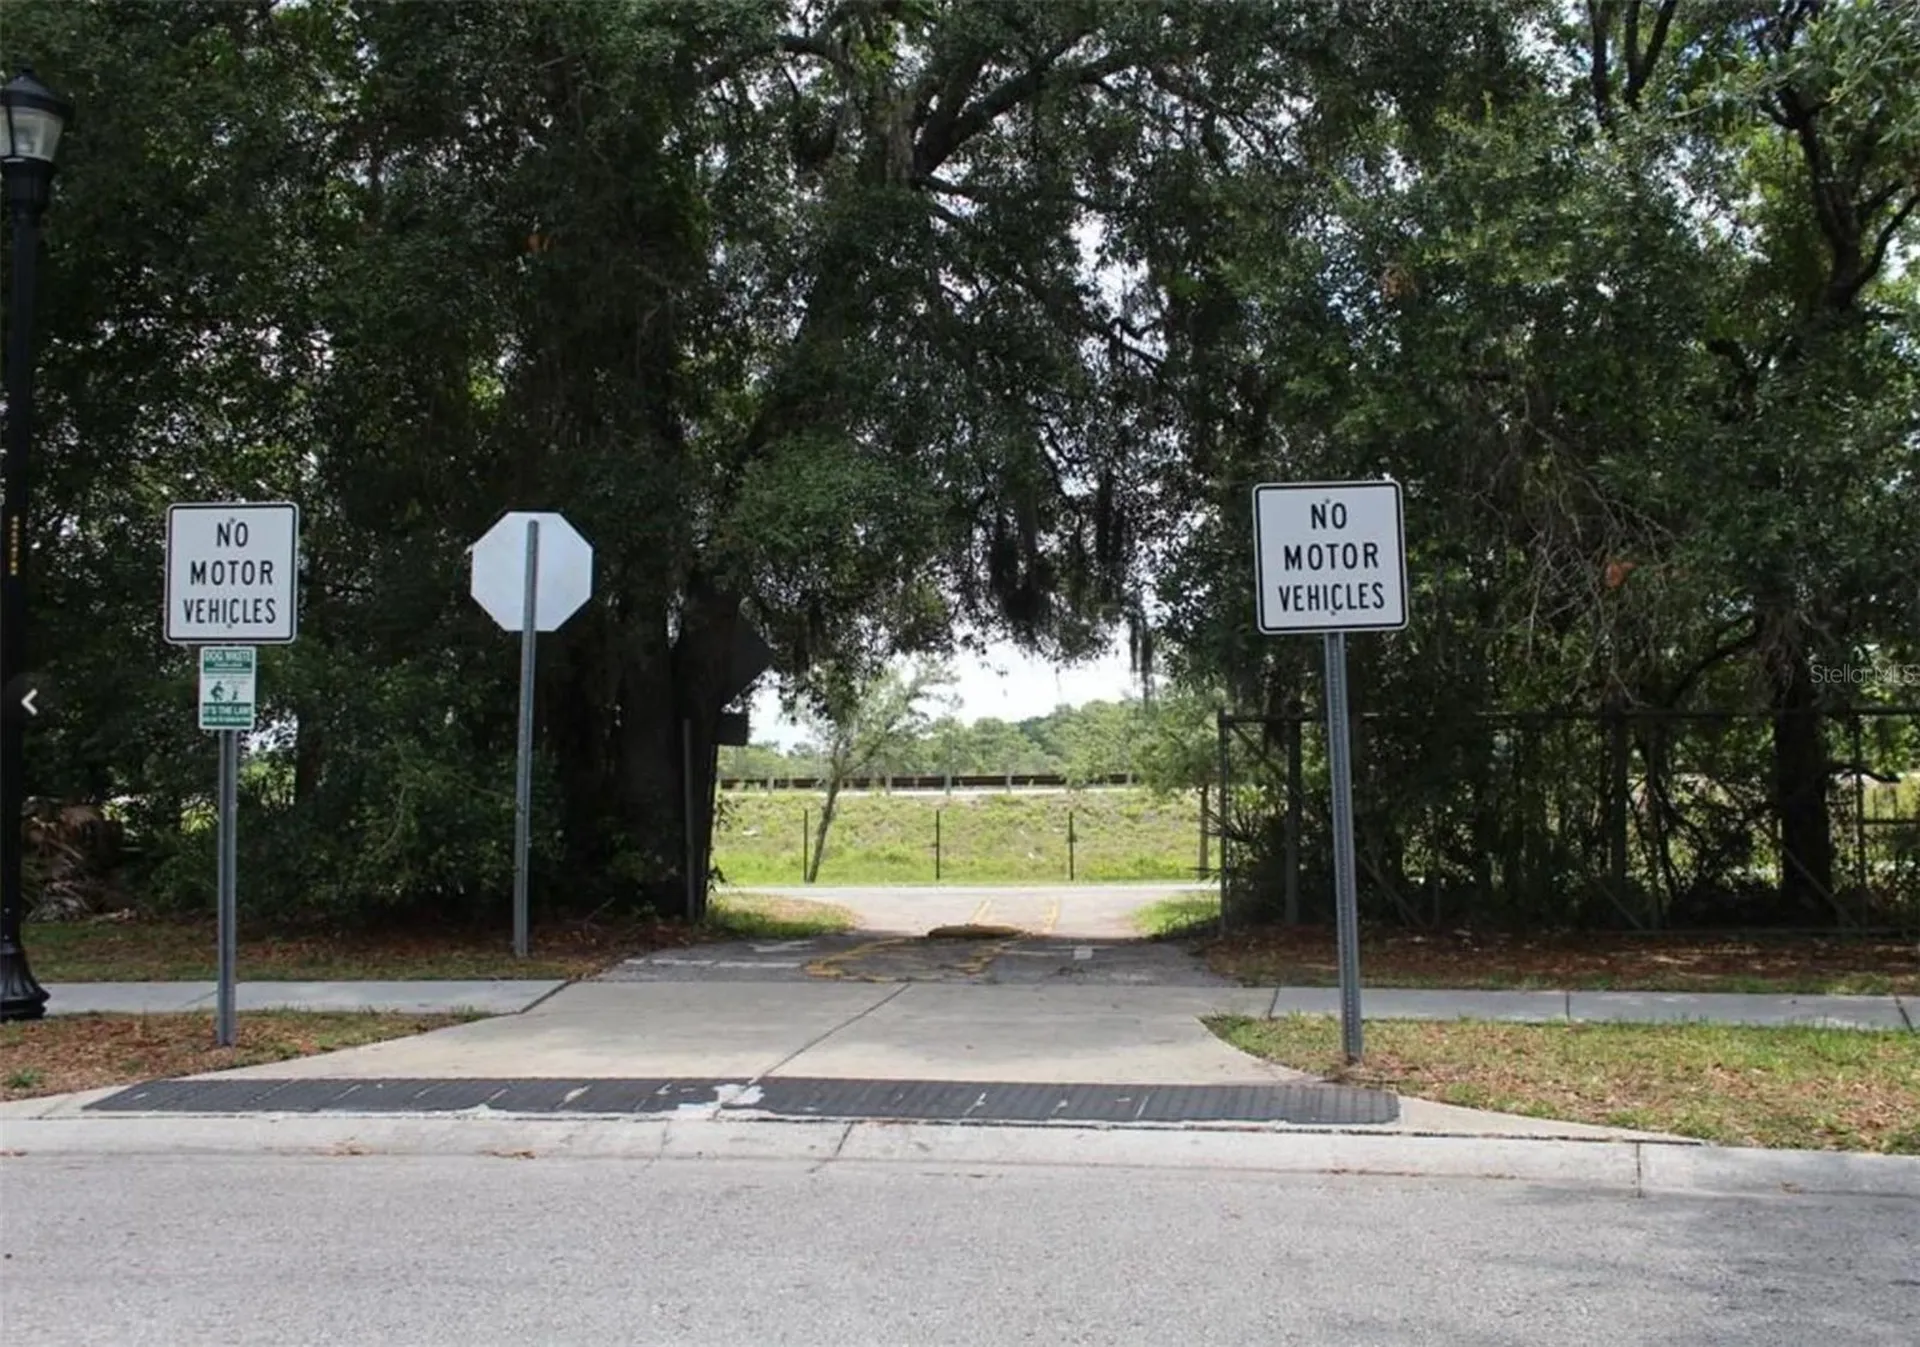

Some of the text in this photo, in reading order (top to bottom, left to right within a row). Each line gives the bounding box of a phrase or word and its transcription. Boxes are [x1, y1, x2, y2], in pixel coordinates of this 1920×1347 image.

[1311, 502, 1347, 529] NO
[216, 522, 249, 548] NO
[1284, 543, 1379, 571] MOTOR
[190, 560, 274, 586] MOTOR
[1279, 582, 1385, 612] VEHICLES
[183, 598, 276, 624] VEHICLES
